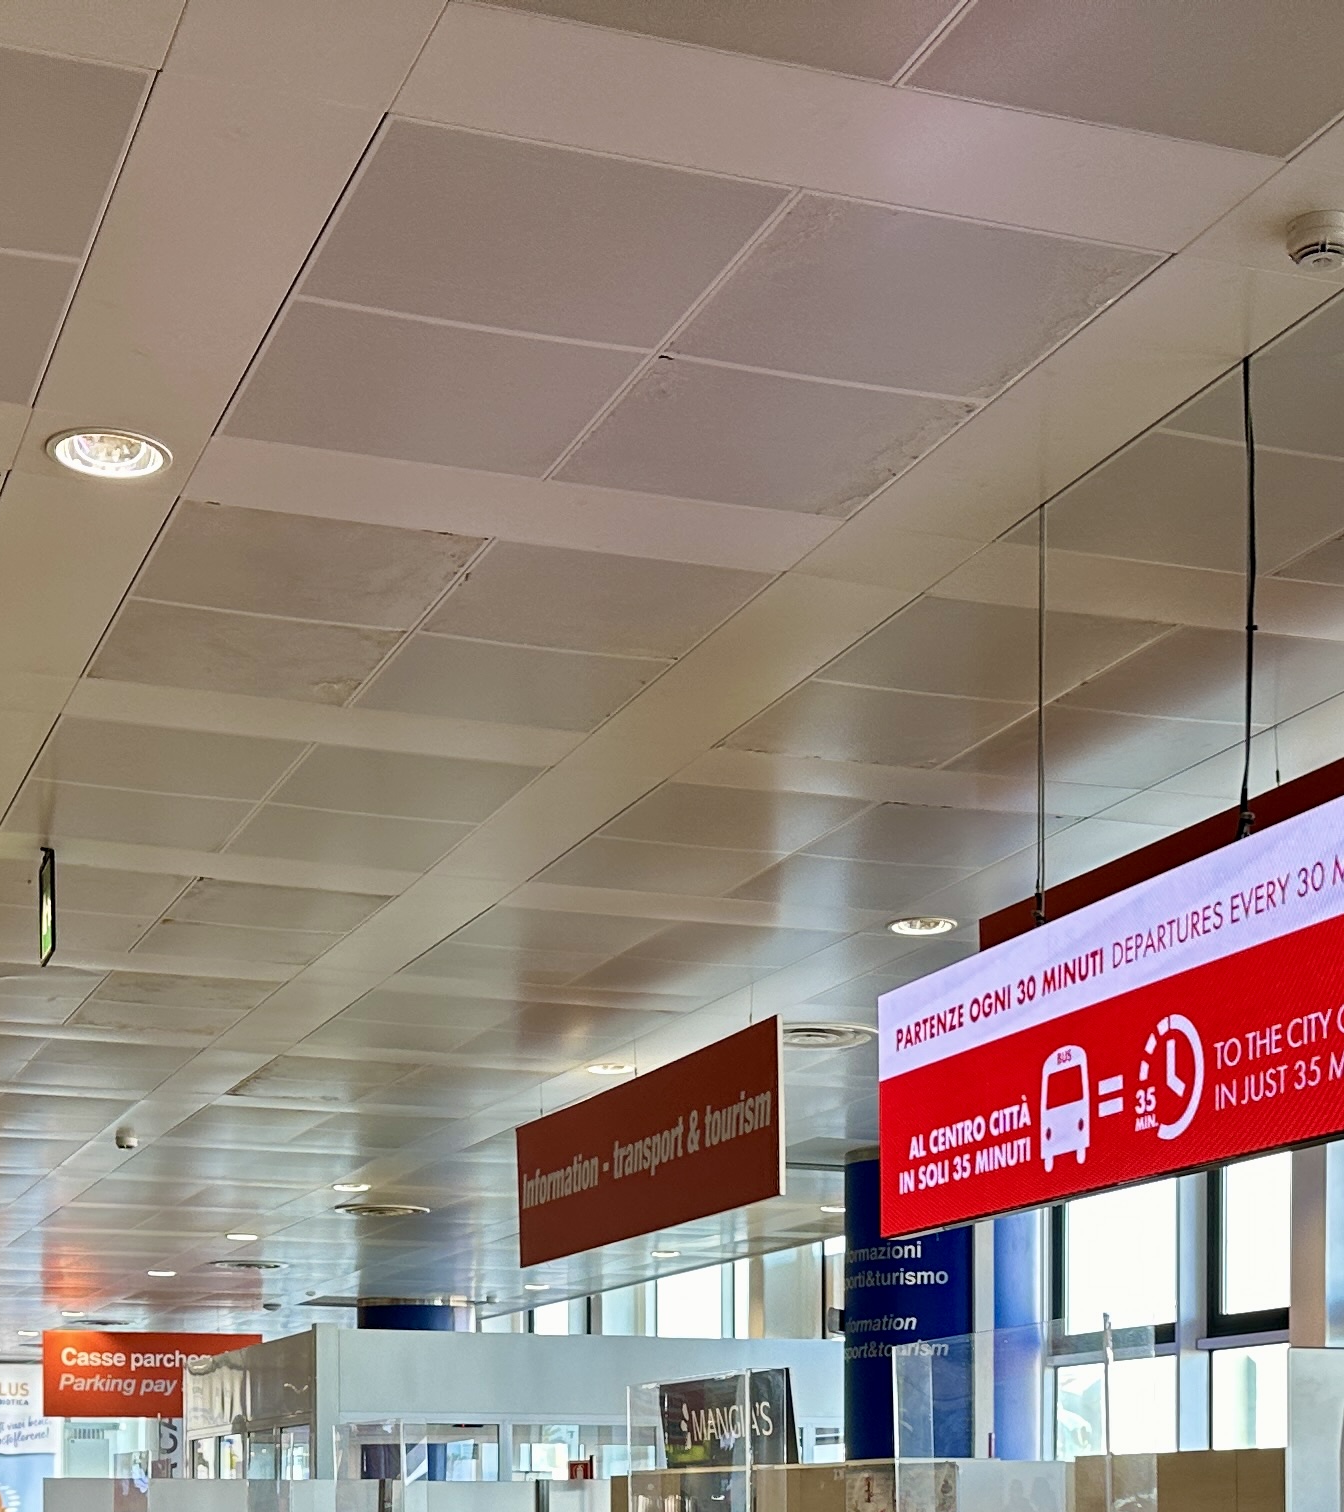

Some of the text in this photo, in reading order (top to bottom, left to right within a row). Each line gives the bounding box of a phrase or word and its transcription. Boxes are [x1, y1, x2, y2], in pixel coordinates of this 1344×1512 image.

[896, 1004, 964, 1051] PARTENZE
[969, 984, 1011, 1023] OGNI
[1017, 975, 1036, 1006] 30
[1042, 947, 1104, 997] MINUTI
[1112, 901, 1223, 969] DEPARTURES
[1230, 871, 1289, 925] EVERY
[1296, 861, 1325, 897] 30
[1214, 1037, 1241, 1069] TO
[1245, 1023, 1282, 1060] THE
[1287, 1008, 1332, 1049] CITY
[1134, 1086, 1156, 1114] 35
[1214, 1080, 1237, 1111] IN
[1240, 1064, 1288, 1106] JUST
[1294, 1055, 1321, 1090] 35
[522, 1089, 772, 1210] Information transport & tourism
[909, 1094, 1031, 1160] AL CENTRO CITTÀ
[1135, 1112, 1159, 1132] MIN.
[899, 1136, 1032, 1195] IN SOLI 35 MINUTI
[59, 1374, 178, 1396] Parking pay
[61, 1347, 126, 1367] Casse
[691, 1401, 774, 1443] MANGIA'S
